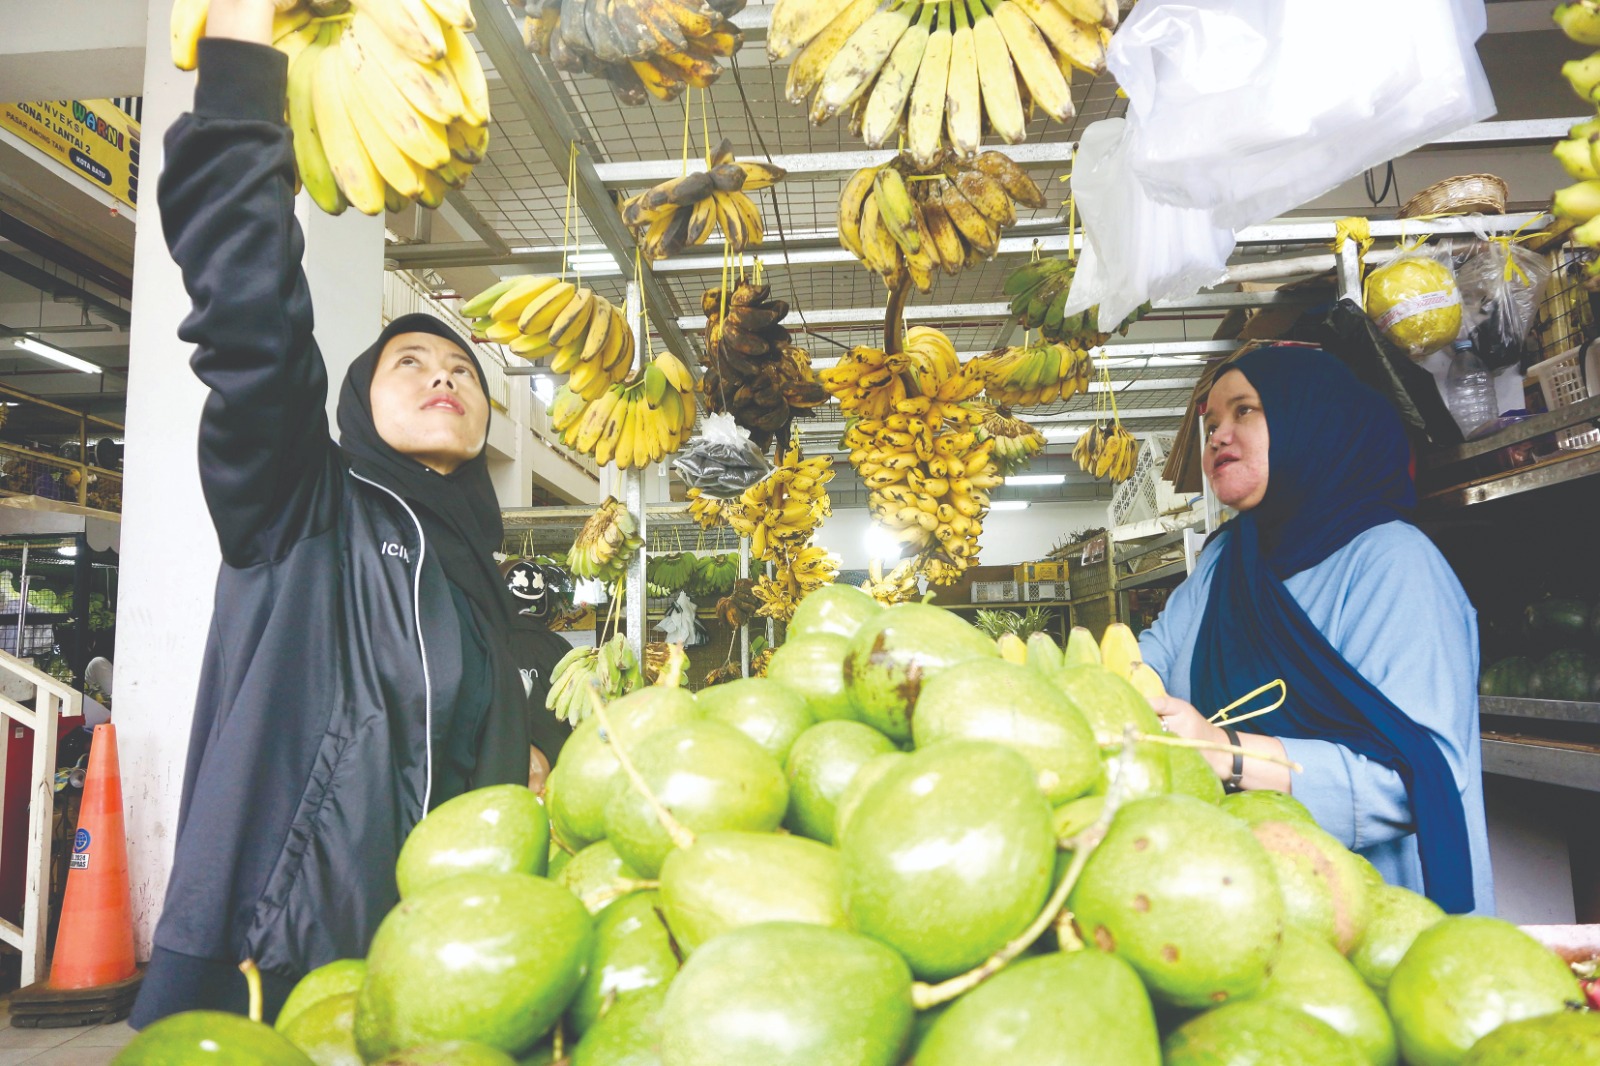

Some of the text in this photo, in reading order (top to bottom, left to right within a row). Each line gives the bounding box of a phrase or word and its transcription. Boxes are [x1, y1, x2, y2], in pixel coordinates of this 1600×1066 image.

[6, 111, 28, 130] PASAR
[17, 102, 42, 123] ZONA
[45, 117, 51, 129] 2
[53, 123, 83, 150] LANTAI
[85, 144, 91, 155] 2
[72, 100, 124, 152] WARNI
[76, 155, 91, 170] KOTA
